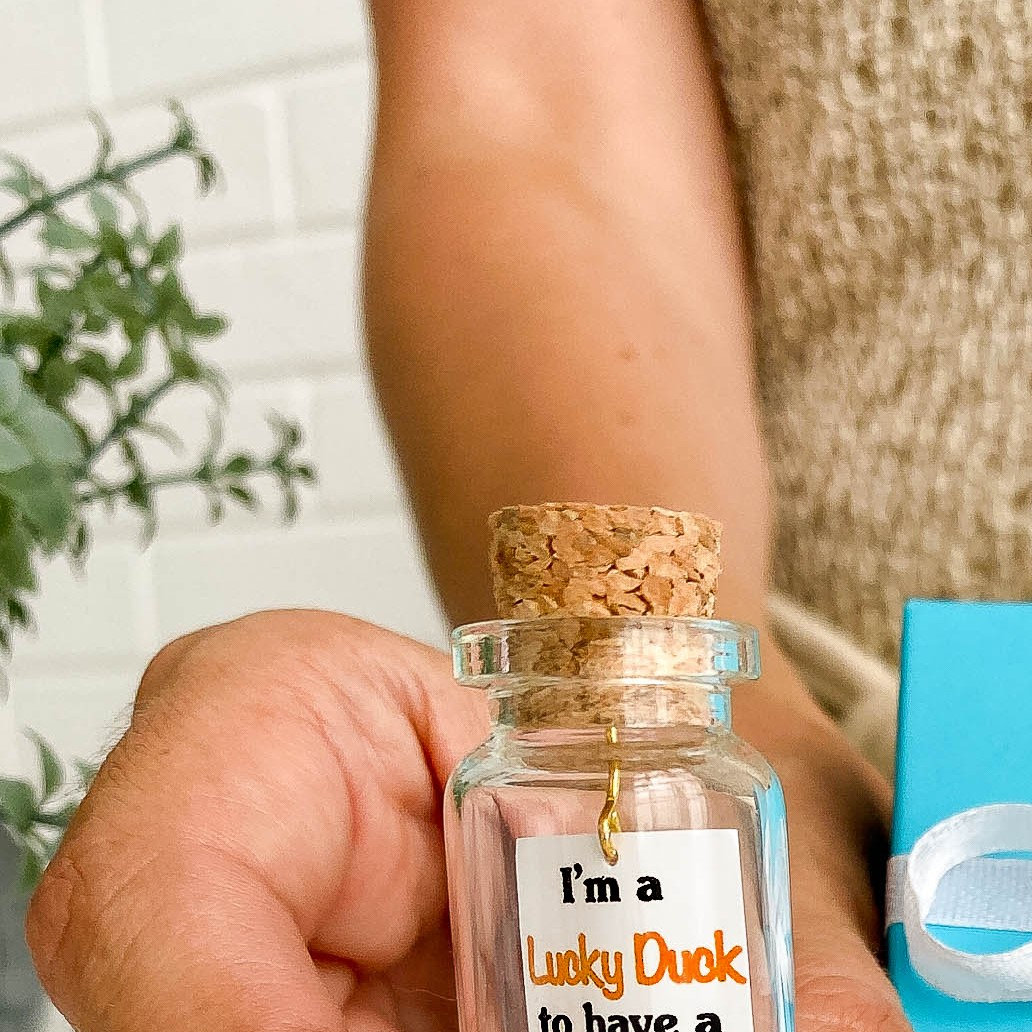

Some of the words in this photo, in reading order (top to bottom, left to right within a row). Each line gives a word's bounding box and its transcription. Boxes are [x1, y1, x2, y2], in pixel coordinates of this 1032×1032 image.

[560, 863, 621, 903] I'm
[636, 876, 664, 902] a
[527, 932, 624, 1000] Lucky
[633, 930, 747, 985] Duck
